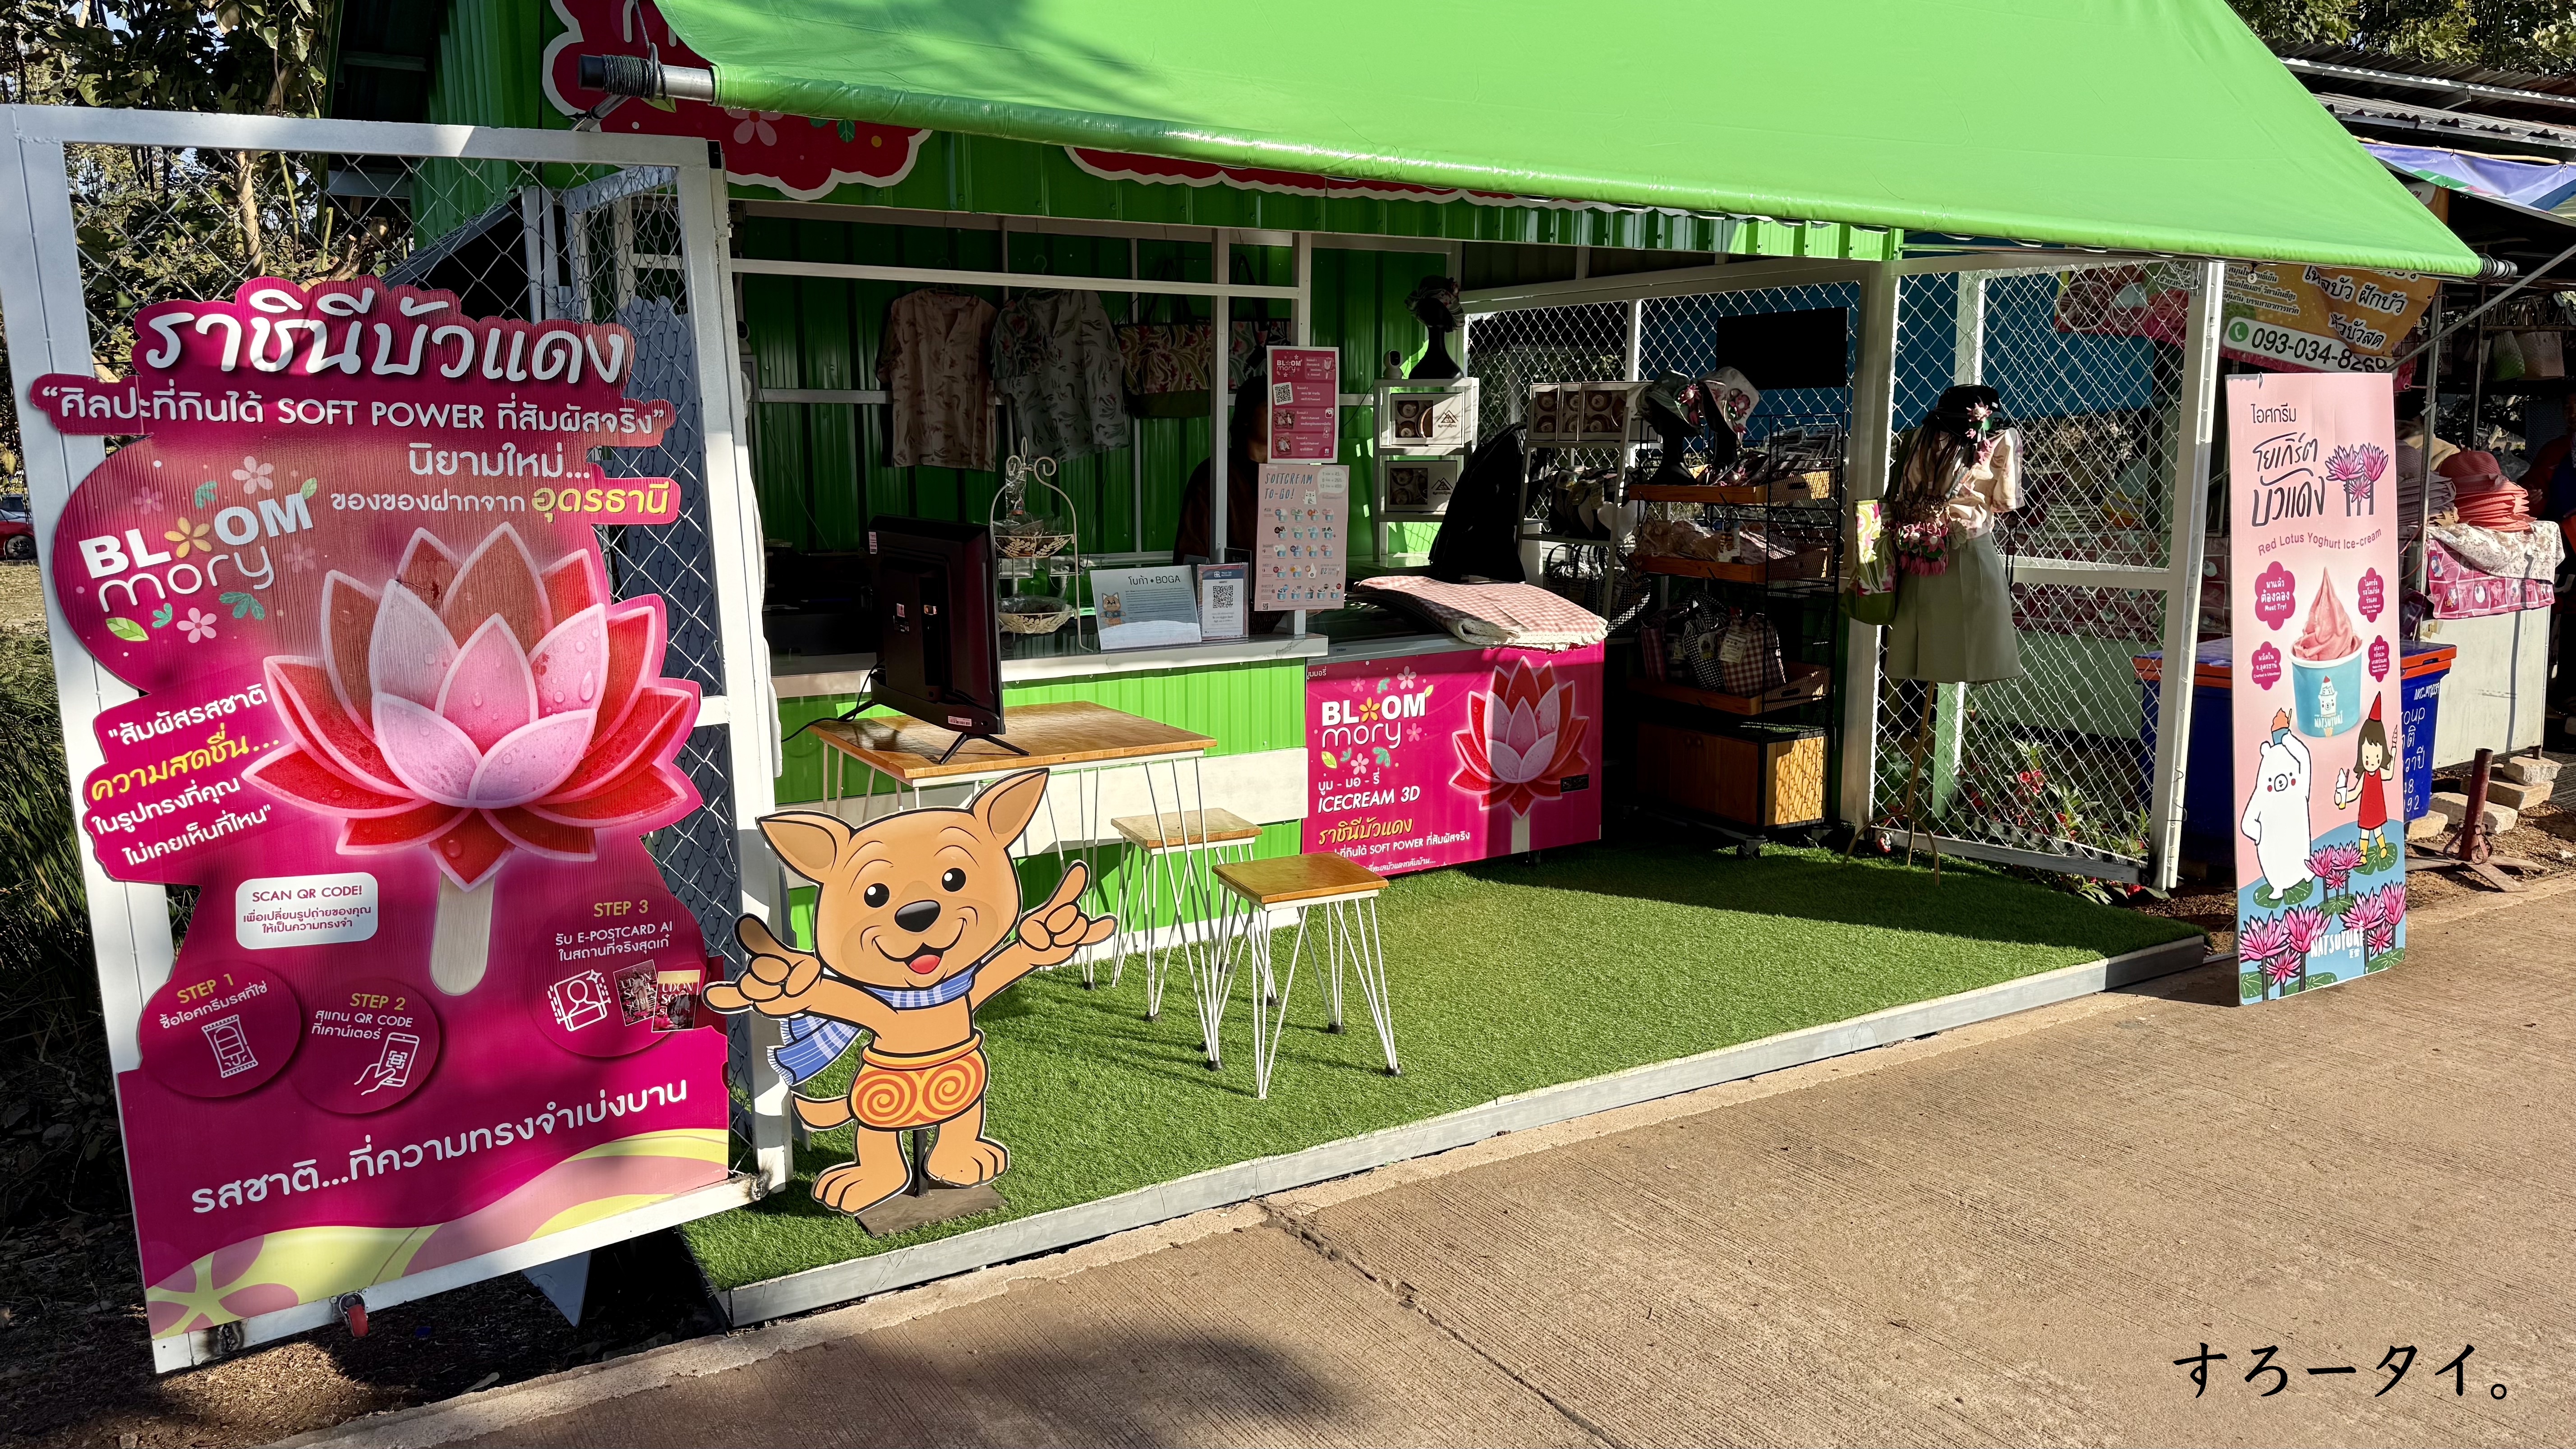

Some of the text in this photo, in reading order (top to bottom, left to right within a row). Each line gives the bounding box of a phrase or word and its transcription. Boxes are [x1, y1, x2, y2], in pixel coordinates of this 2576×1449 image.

[2358, 285, 2405, 313] ฝักบัว
[146, 287, 624, 384] ราชินีบัวแดง
[2331, 314, 2385, 347] หัวบัวสด
[278, 398, 358, 425] SOFT
[372, 402, 484, 429] POWER
[2251, 403, 2296, 423] ไอศกรีม
[409, 442, 590, 478] นิยามใหม่...
[2253, 432, 2318, 472] โยเกิร์ต
[1265, 473, 1313, 485] SOFTCREAM
[331, 481, 669, 520] ของของฝากจาก อุดรธานี
[1265, 488, 1295, 500] TO-GO!
[2252, 468, 2325, 527] บัวแดง
[2258, 528, 2381, 556] Red Lotus Yoghurt Ice-cream
[98, 546, 274, 612] mory
[1128, 575, 1181, 585] โบก้า BOGA
[2261, 589, 2290, 603] ต้องลอง
[2401, 708, 2425, 724] oup
[1322, 722, 1401, 749] mory
[92, 723, 279, 800] ความสดชื่น...
[92, 776, 240, 835] ในรูปทรงที่คุณ
[1318, 786, 1420, 814] ICECREAM 3D
[2404, 795, 2419, 812] 92
[1318, 816, 1413, 845] ราชินีบัวแดง
[1370, 842, 1389, 854] SOFT
[1393, 838, 1423, 851] POWER
[1426, 831, 1471, 846] ที่สัมผัสจริง
[252, 885, 362, 902] SCAN QR CODE!
[243, 906, 371, 923] เพื่อเปลี่ยนรูปถ่ายของคุณ
[593, 900, 649, 918] STEP 3
[262, 918, 352, 934] ให้เป็นความทรงจำ
[556, 921, 672, 946] รับ E-POSTCARD AI
[177, 974, 234, 1004] STEP 1
[350, 993, 406, 1010] STEP 2
[159, 980, 268, 1029] ซื้อไอศกรีมรสที่ใช่
[312, 1020, 382, 1040] ที่เคาน์เตอร์
[315, 1009, 413, 1028] สแกน QR CODE
